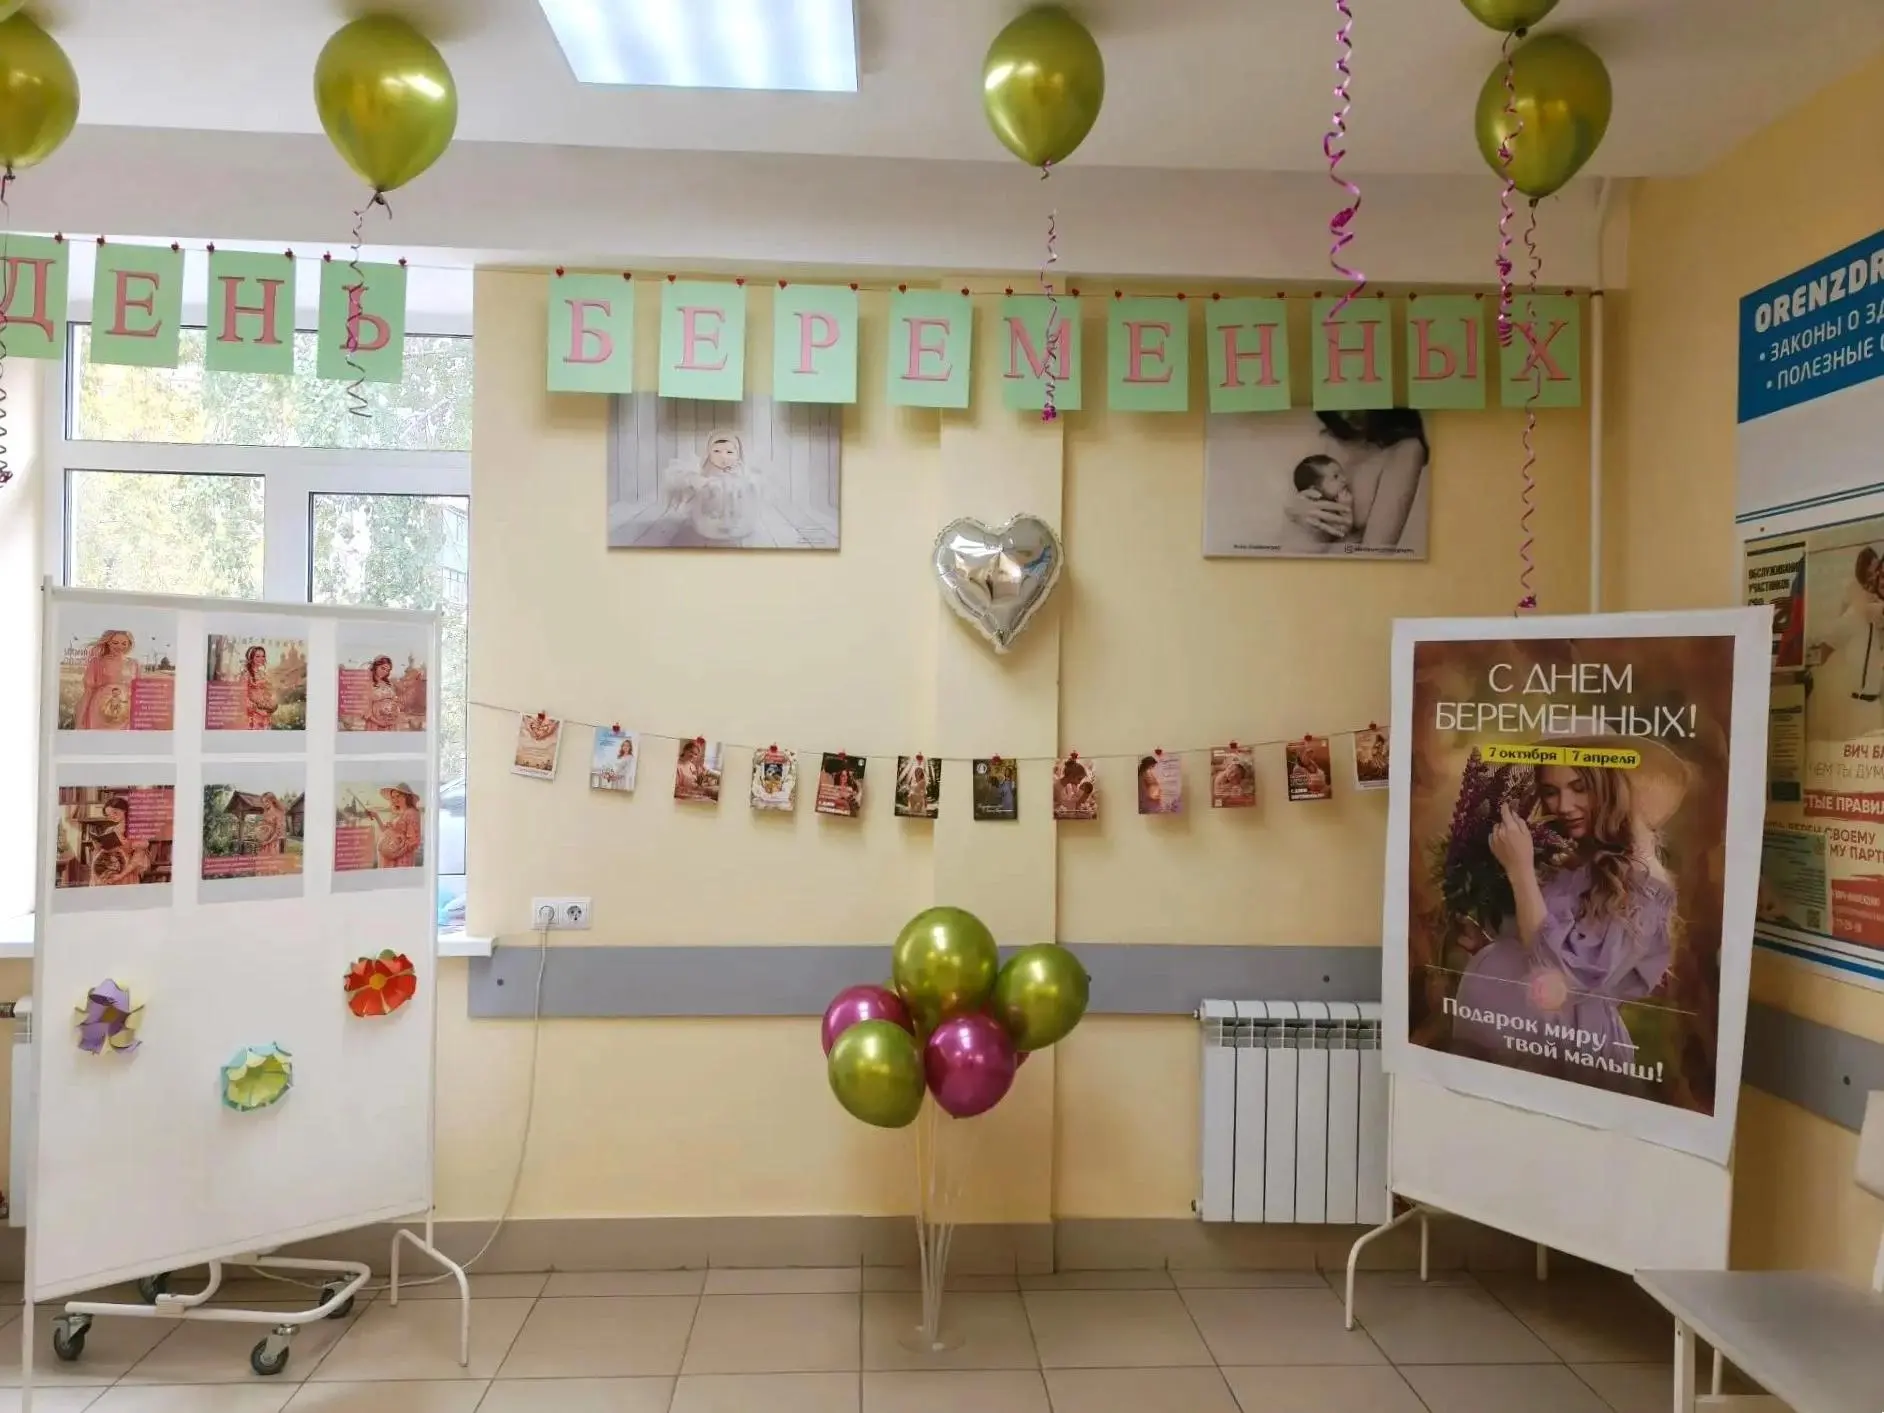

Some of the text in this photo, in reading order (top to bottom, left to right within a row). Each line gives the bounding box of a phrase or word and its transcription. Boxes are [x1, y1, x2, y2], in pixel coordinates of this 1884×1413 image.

[1755, 248, 1884, 333] ORENZDR
[0, 256, 1572, 387] ДЕНЬ БЕРЕМЕННЫХ
[1770, 316, 1842, 361] ЗАКОНЫ
[1777, 337, 1874, 390] ПОЛЕЗНЫЕ
[1488, 663, 1633, 695] С ДНЕМ
[1435, 702, 1697, 738] БЕРЕМЕННЫХ!
[1488, 747, 1557, 762] 7 октября
[1572, 750, 1636, 766] 7 апреля
[1843, 744, 1869, 758] ВИЧ
[1804, 795, 1833, 810] ТЫЕ
[1850, 846, 1884, 864] ПАРТ
[1443, 998, 1539, 1034] Подарок
[1544, 1022, 1607, 1051] миру
[1504, 1035, 1664, 1083] твой малыш!
